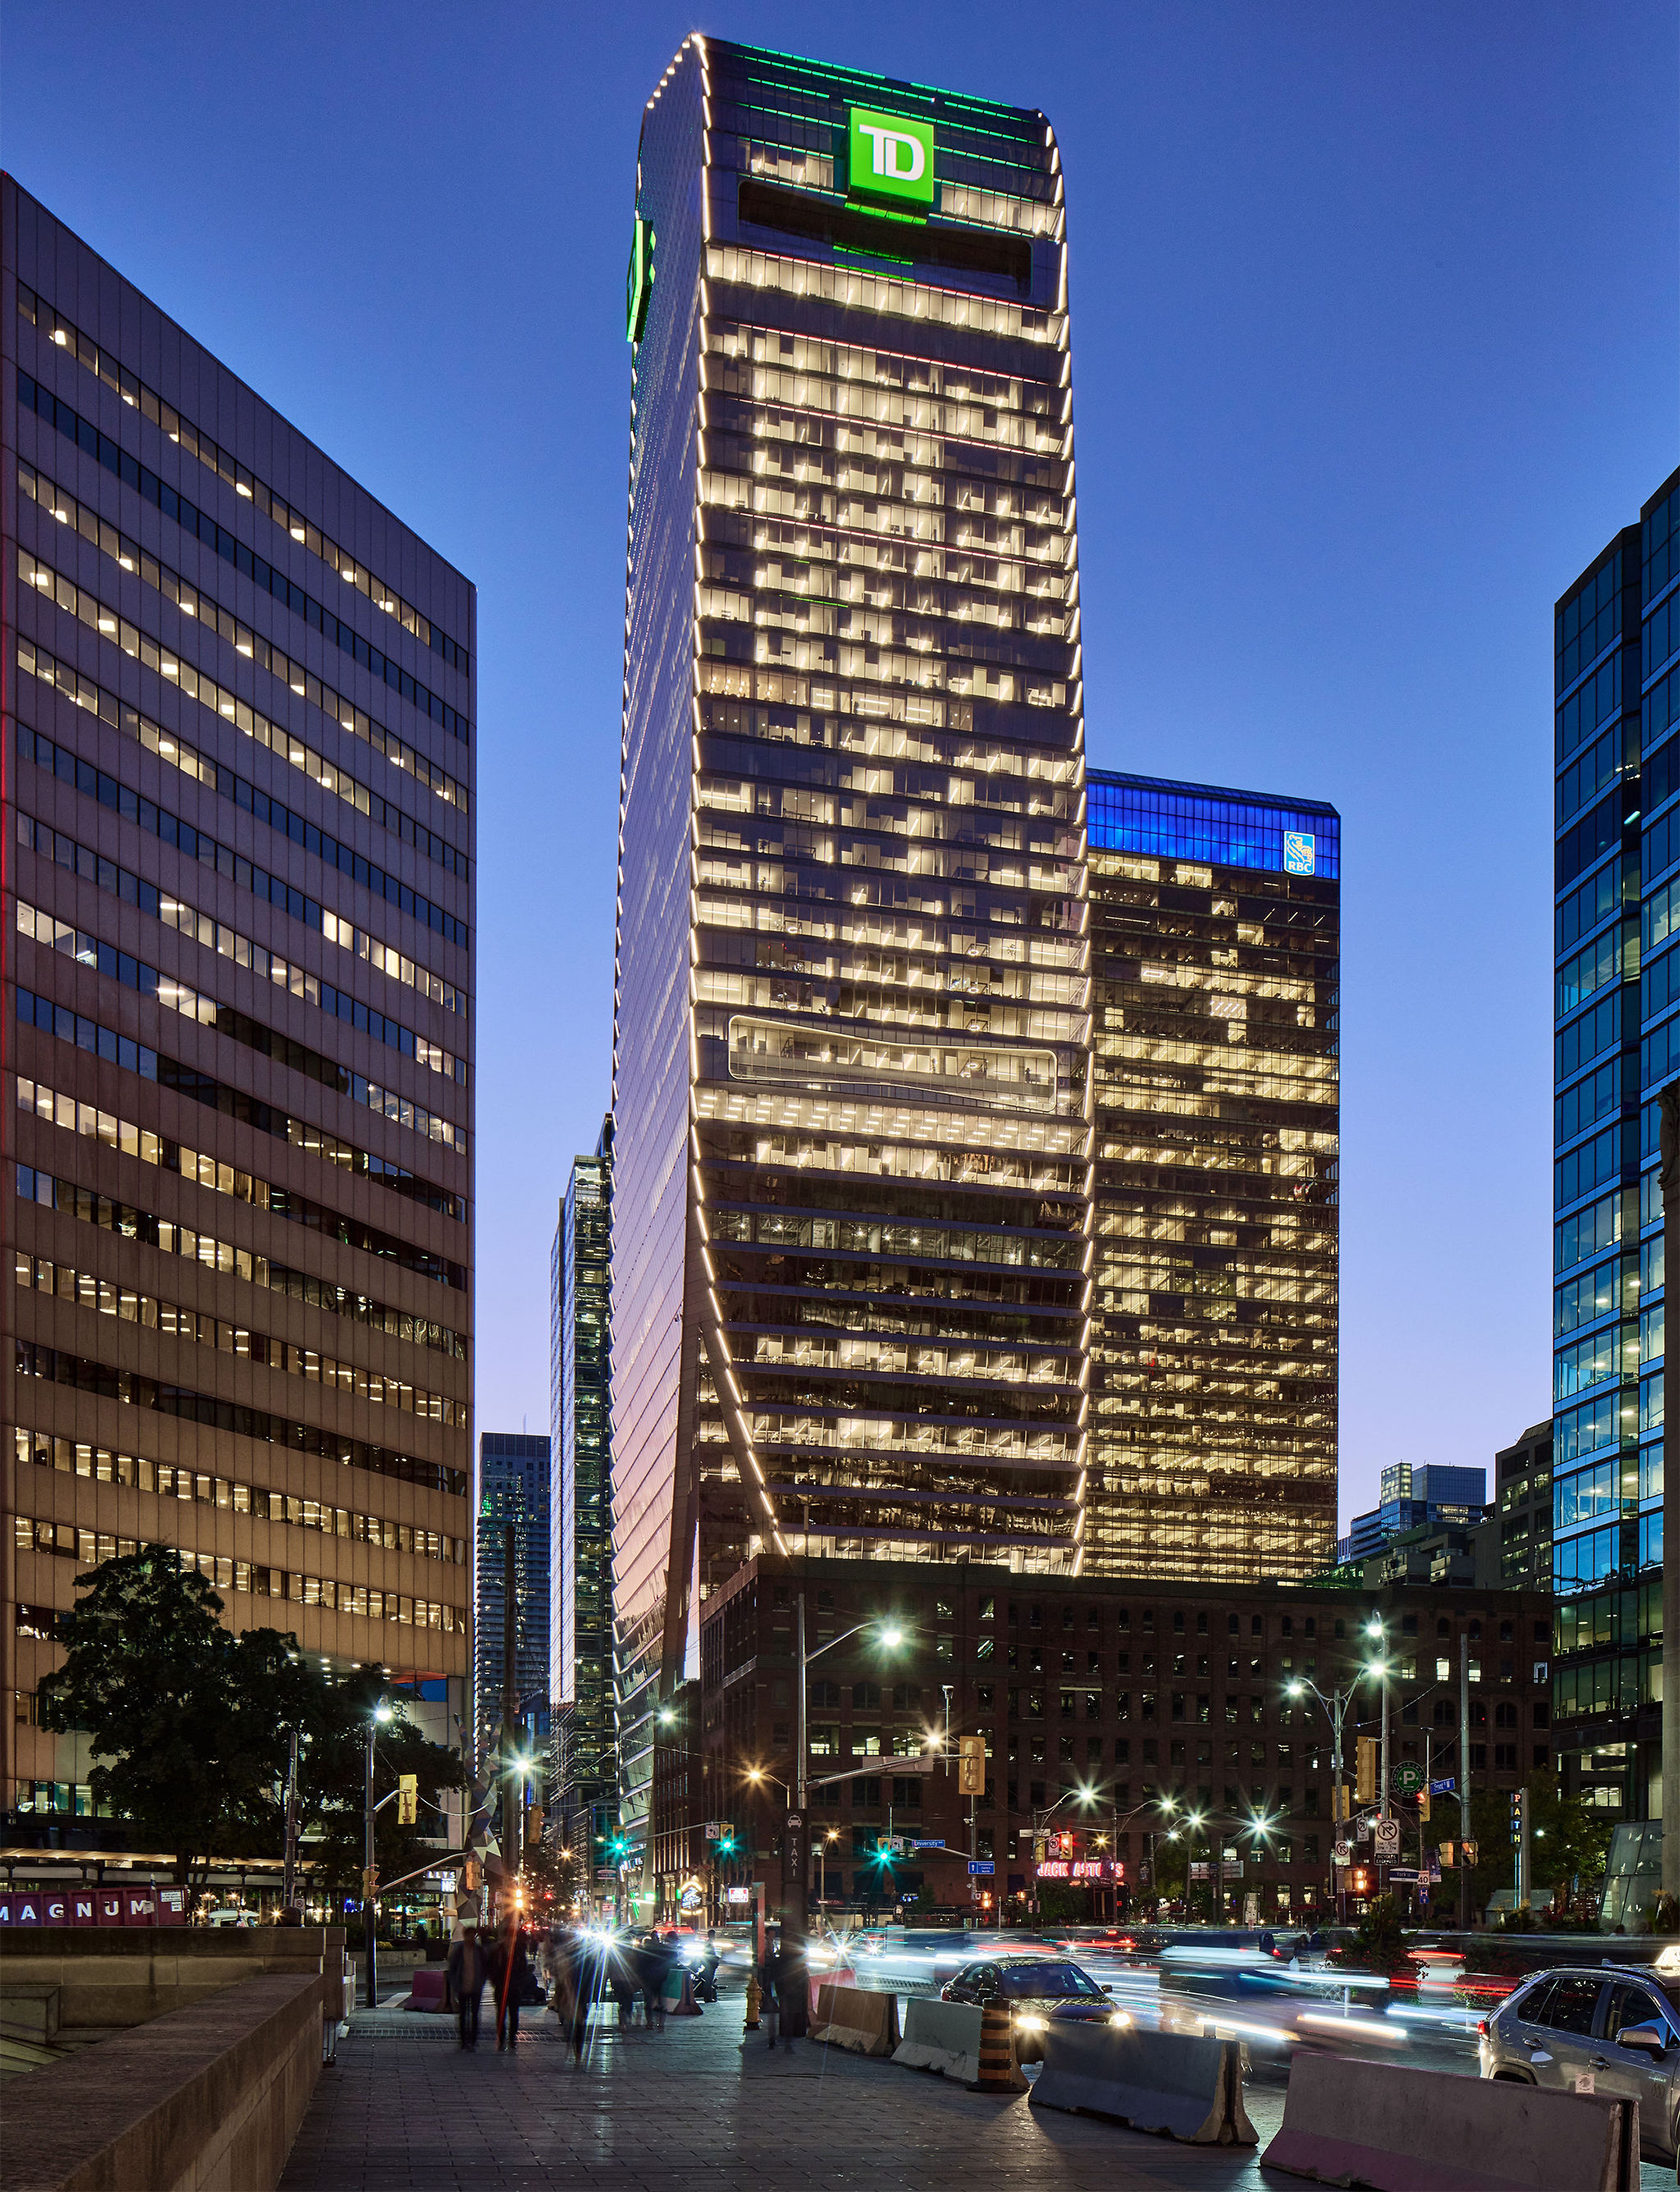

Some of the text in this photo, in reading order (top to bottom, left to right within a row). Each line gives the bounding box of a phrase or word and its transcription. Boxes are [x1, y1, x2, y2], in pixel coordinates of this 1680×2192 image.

[859, 124, 925, 182] TD
[1288, 861, 1312, 873] RBC
[1403, 1771, 1416, 1785] P
[427, 1871, 456, 1879] LLYS
[1037, 1862, 1124, 1877] JACK ASTO'S
[1418, 1876, 1429, 1884] 40
[0, 1900, 147, 1921] MAGNUM
